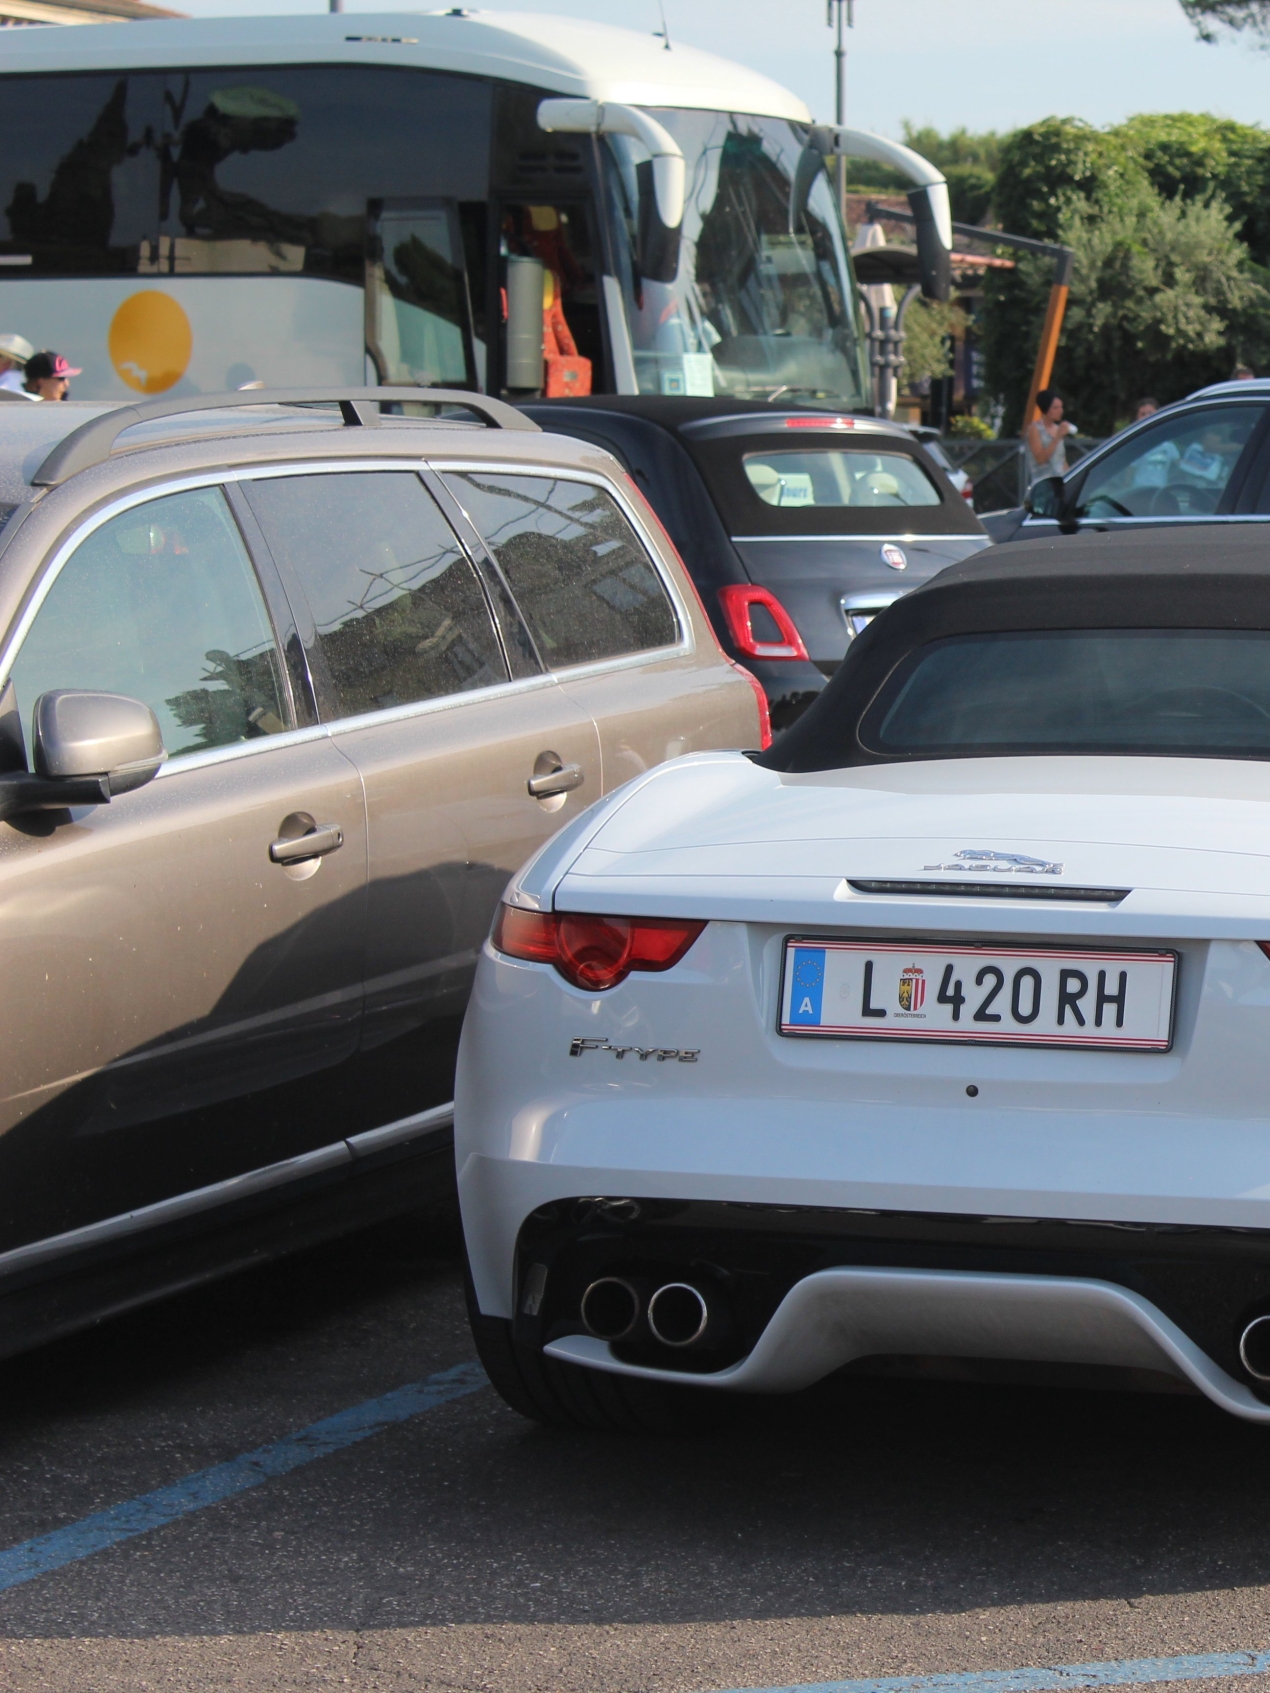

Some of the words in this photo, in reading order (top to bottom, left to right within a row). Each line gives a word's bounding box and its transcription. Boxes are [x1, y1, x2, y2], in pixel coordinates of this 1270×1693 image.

[799, 997, 813, 1014] A
[861, 960, 887, 1018] L
[569, 1036, 701, 1063] F-TYPE
